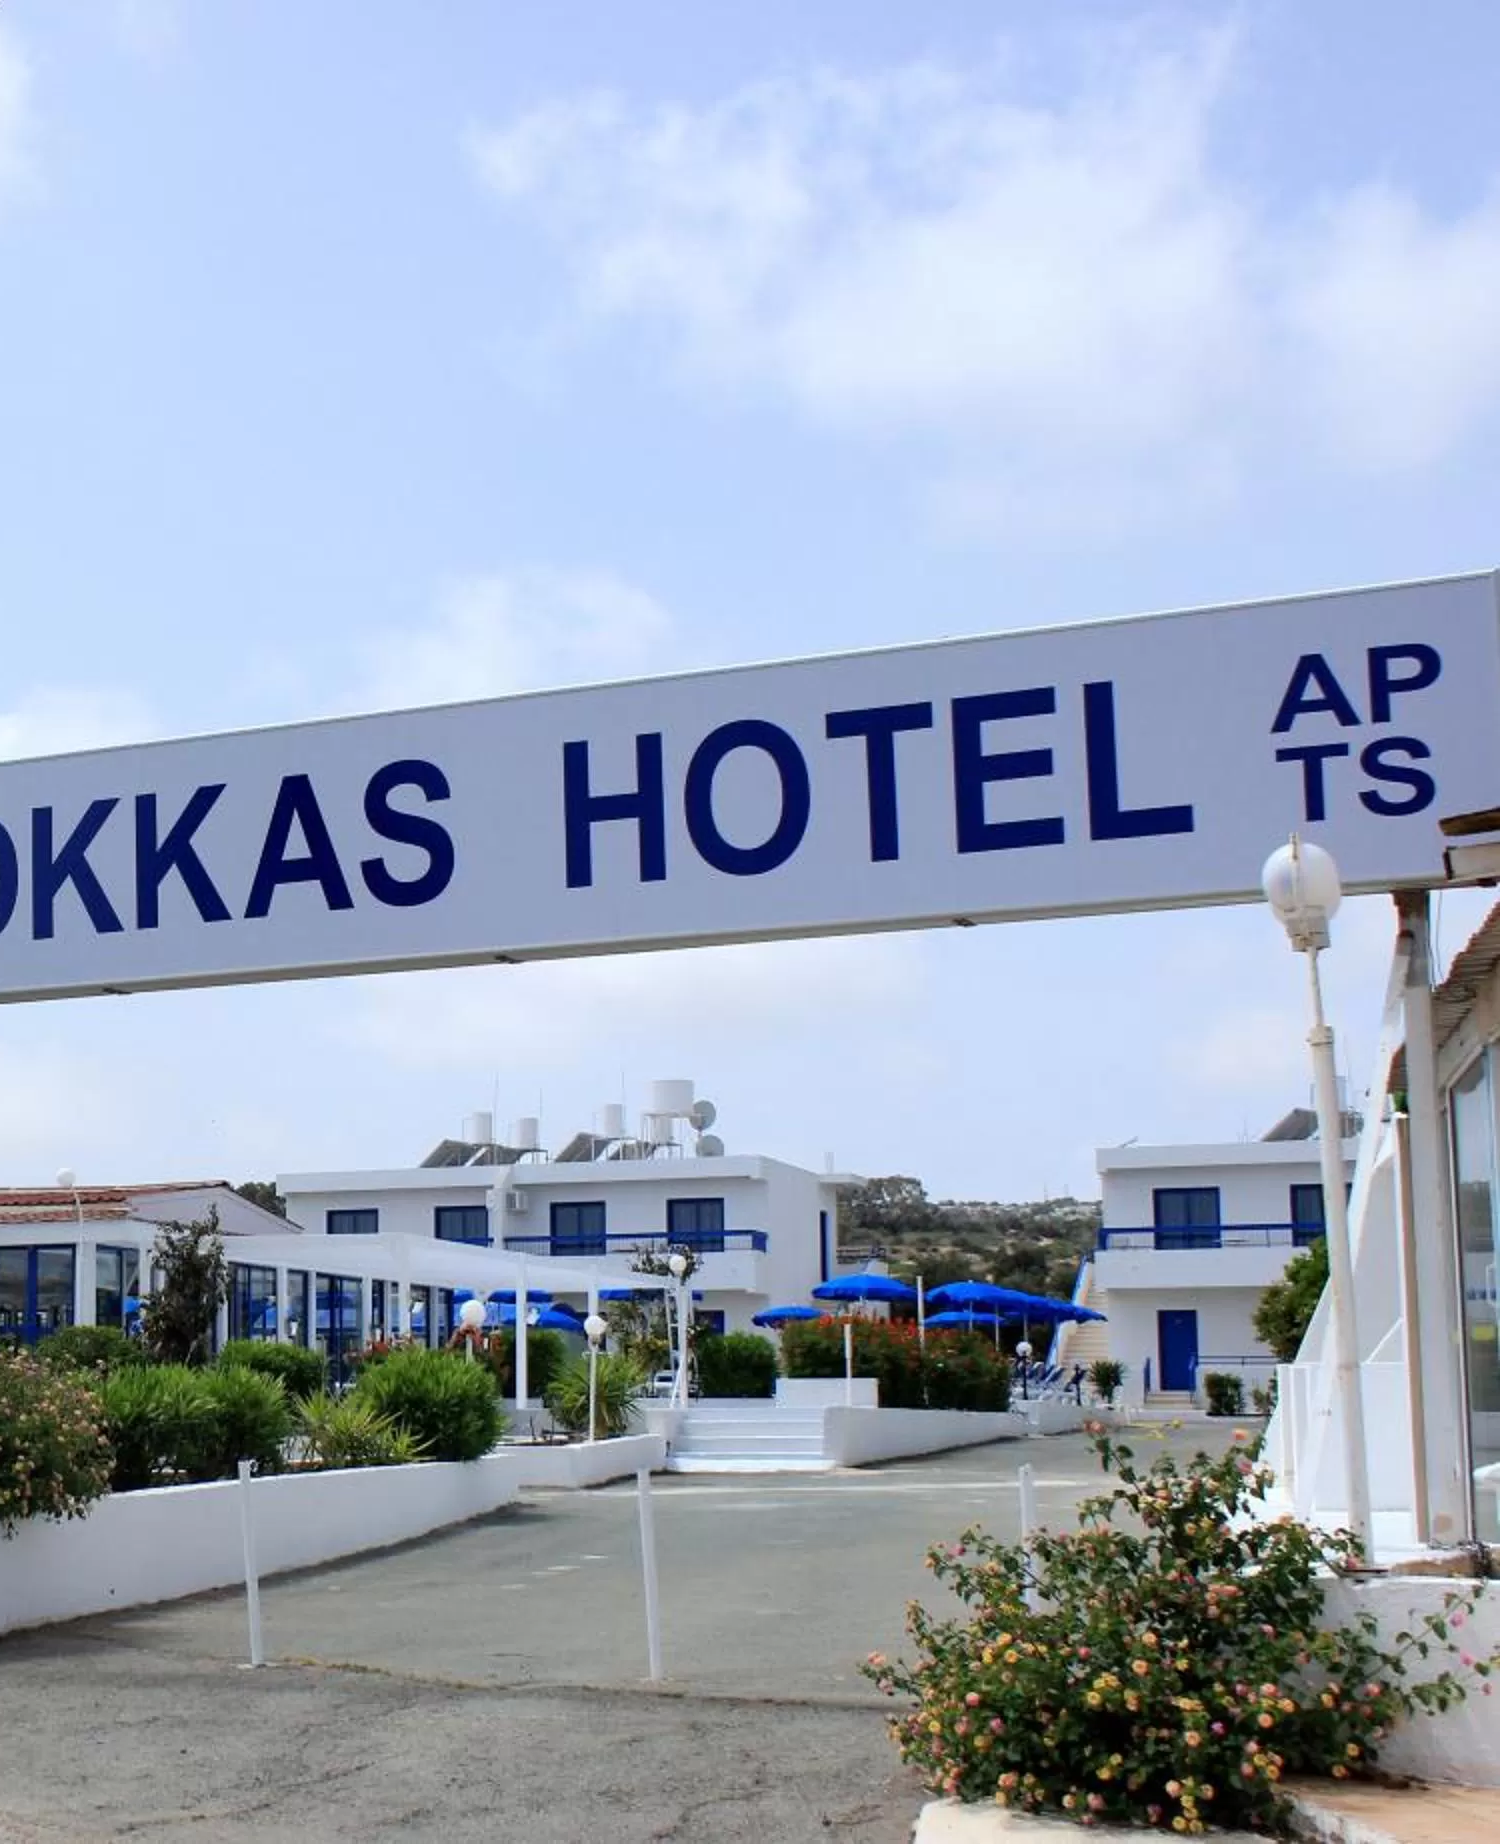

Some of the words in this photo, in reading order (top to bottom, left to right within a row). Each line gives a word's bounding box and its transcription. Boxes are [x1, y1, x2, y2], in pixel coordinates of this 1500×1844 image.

[1270, 643, 1442, 733] AP
[562, 681, 1194, 888] HOTEL
[1275, 736, 1437, 822] TS
